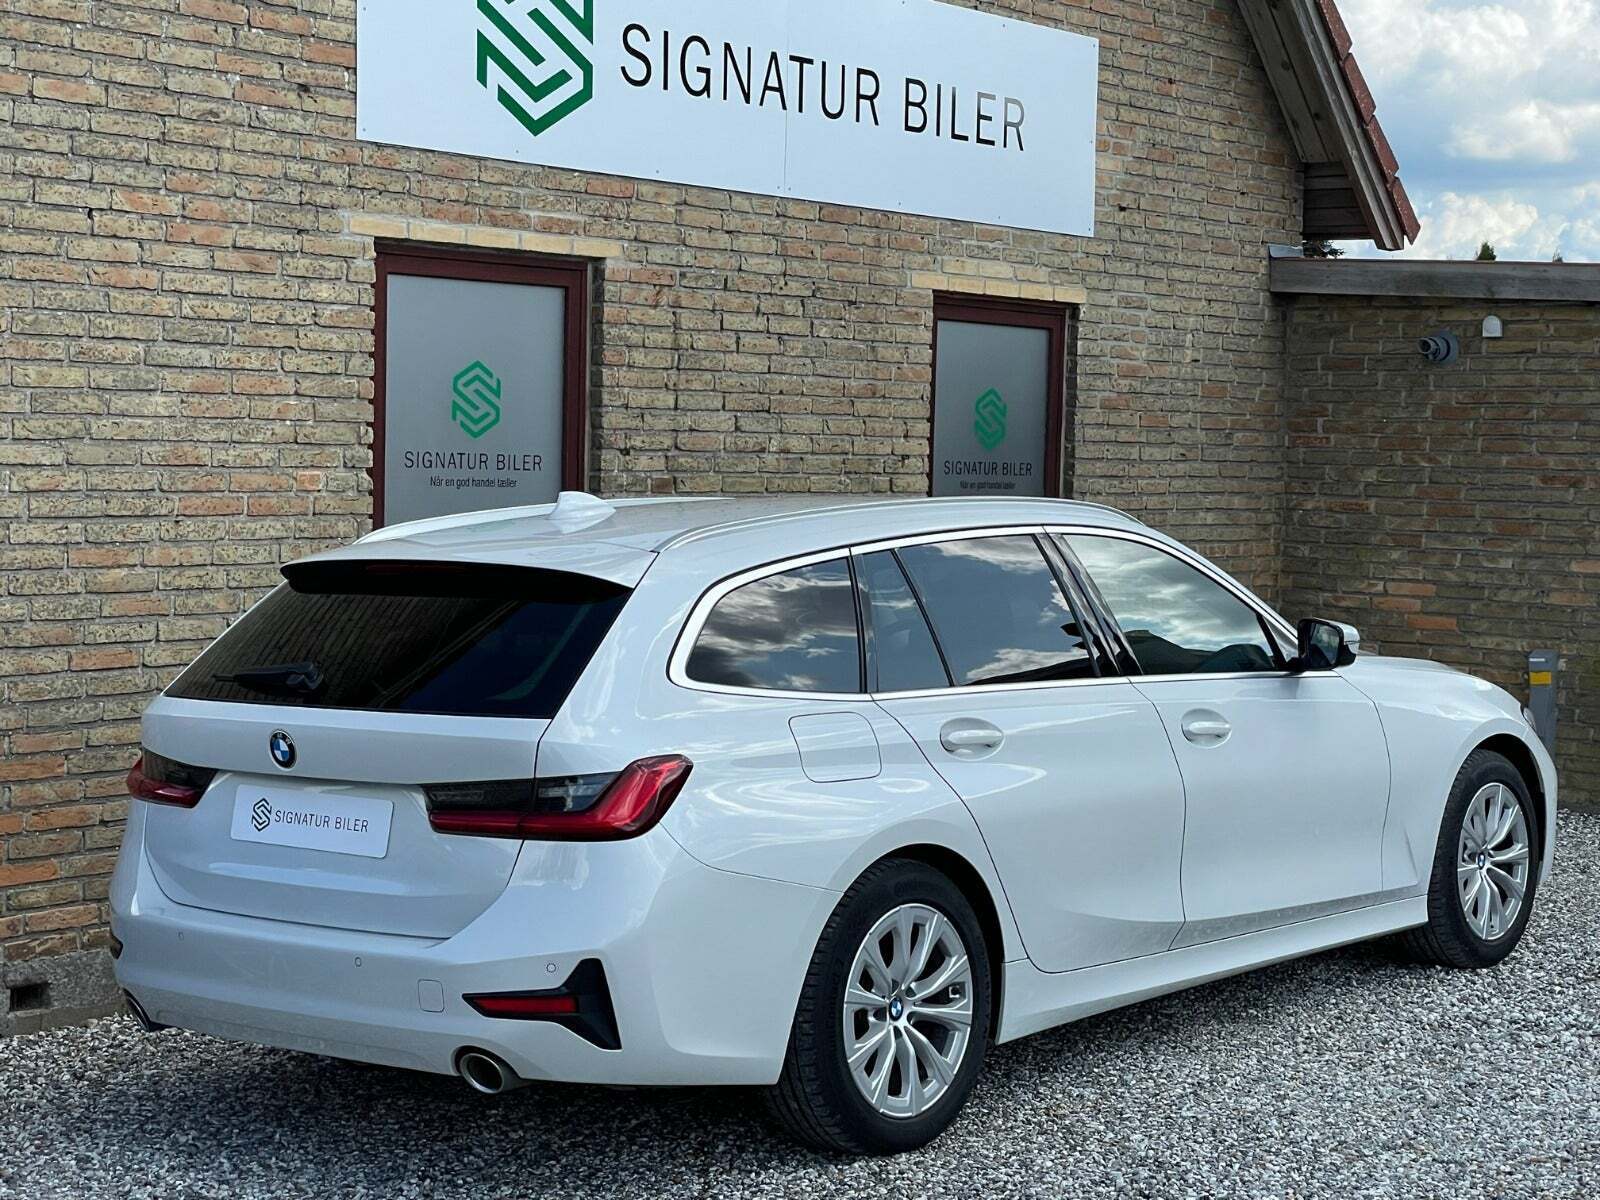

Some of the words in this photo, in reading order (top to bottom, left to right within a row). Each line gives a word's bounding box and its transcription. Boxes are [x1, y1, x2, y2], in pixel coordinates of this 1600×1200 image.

[620, 23, 880, 126] SIGNATUR
[904, 77, 1025, 151] BILER
[404, 451, 489, 470] SIGNATUR
[496, 454, 543, 471] BILER
[944, 460, 998, 476] SIGNATUR
[1002, 462, 1032, 476] BILER
[430, 476, 443, 487] Når
[445, 478, 455, 487] en
[456, 477, 470, 489] god
[471, 477, 496, 488] handel
[274, 810, 330, 829] SIGNATUR
[335, 817, 369, 833] BILER
